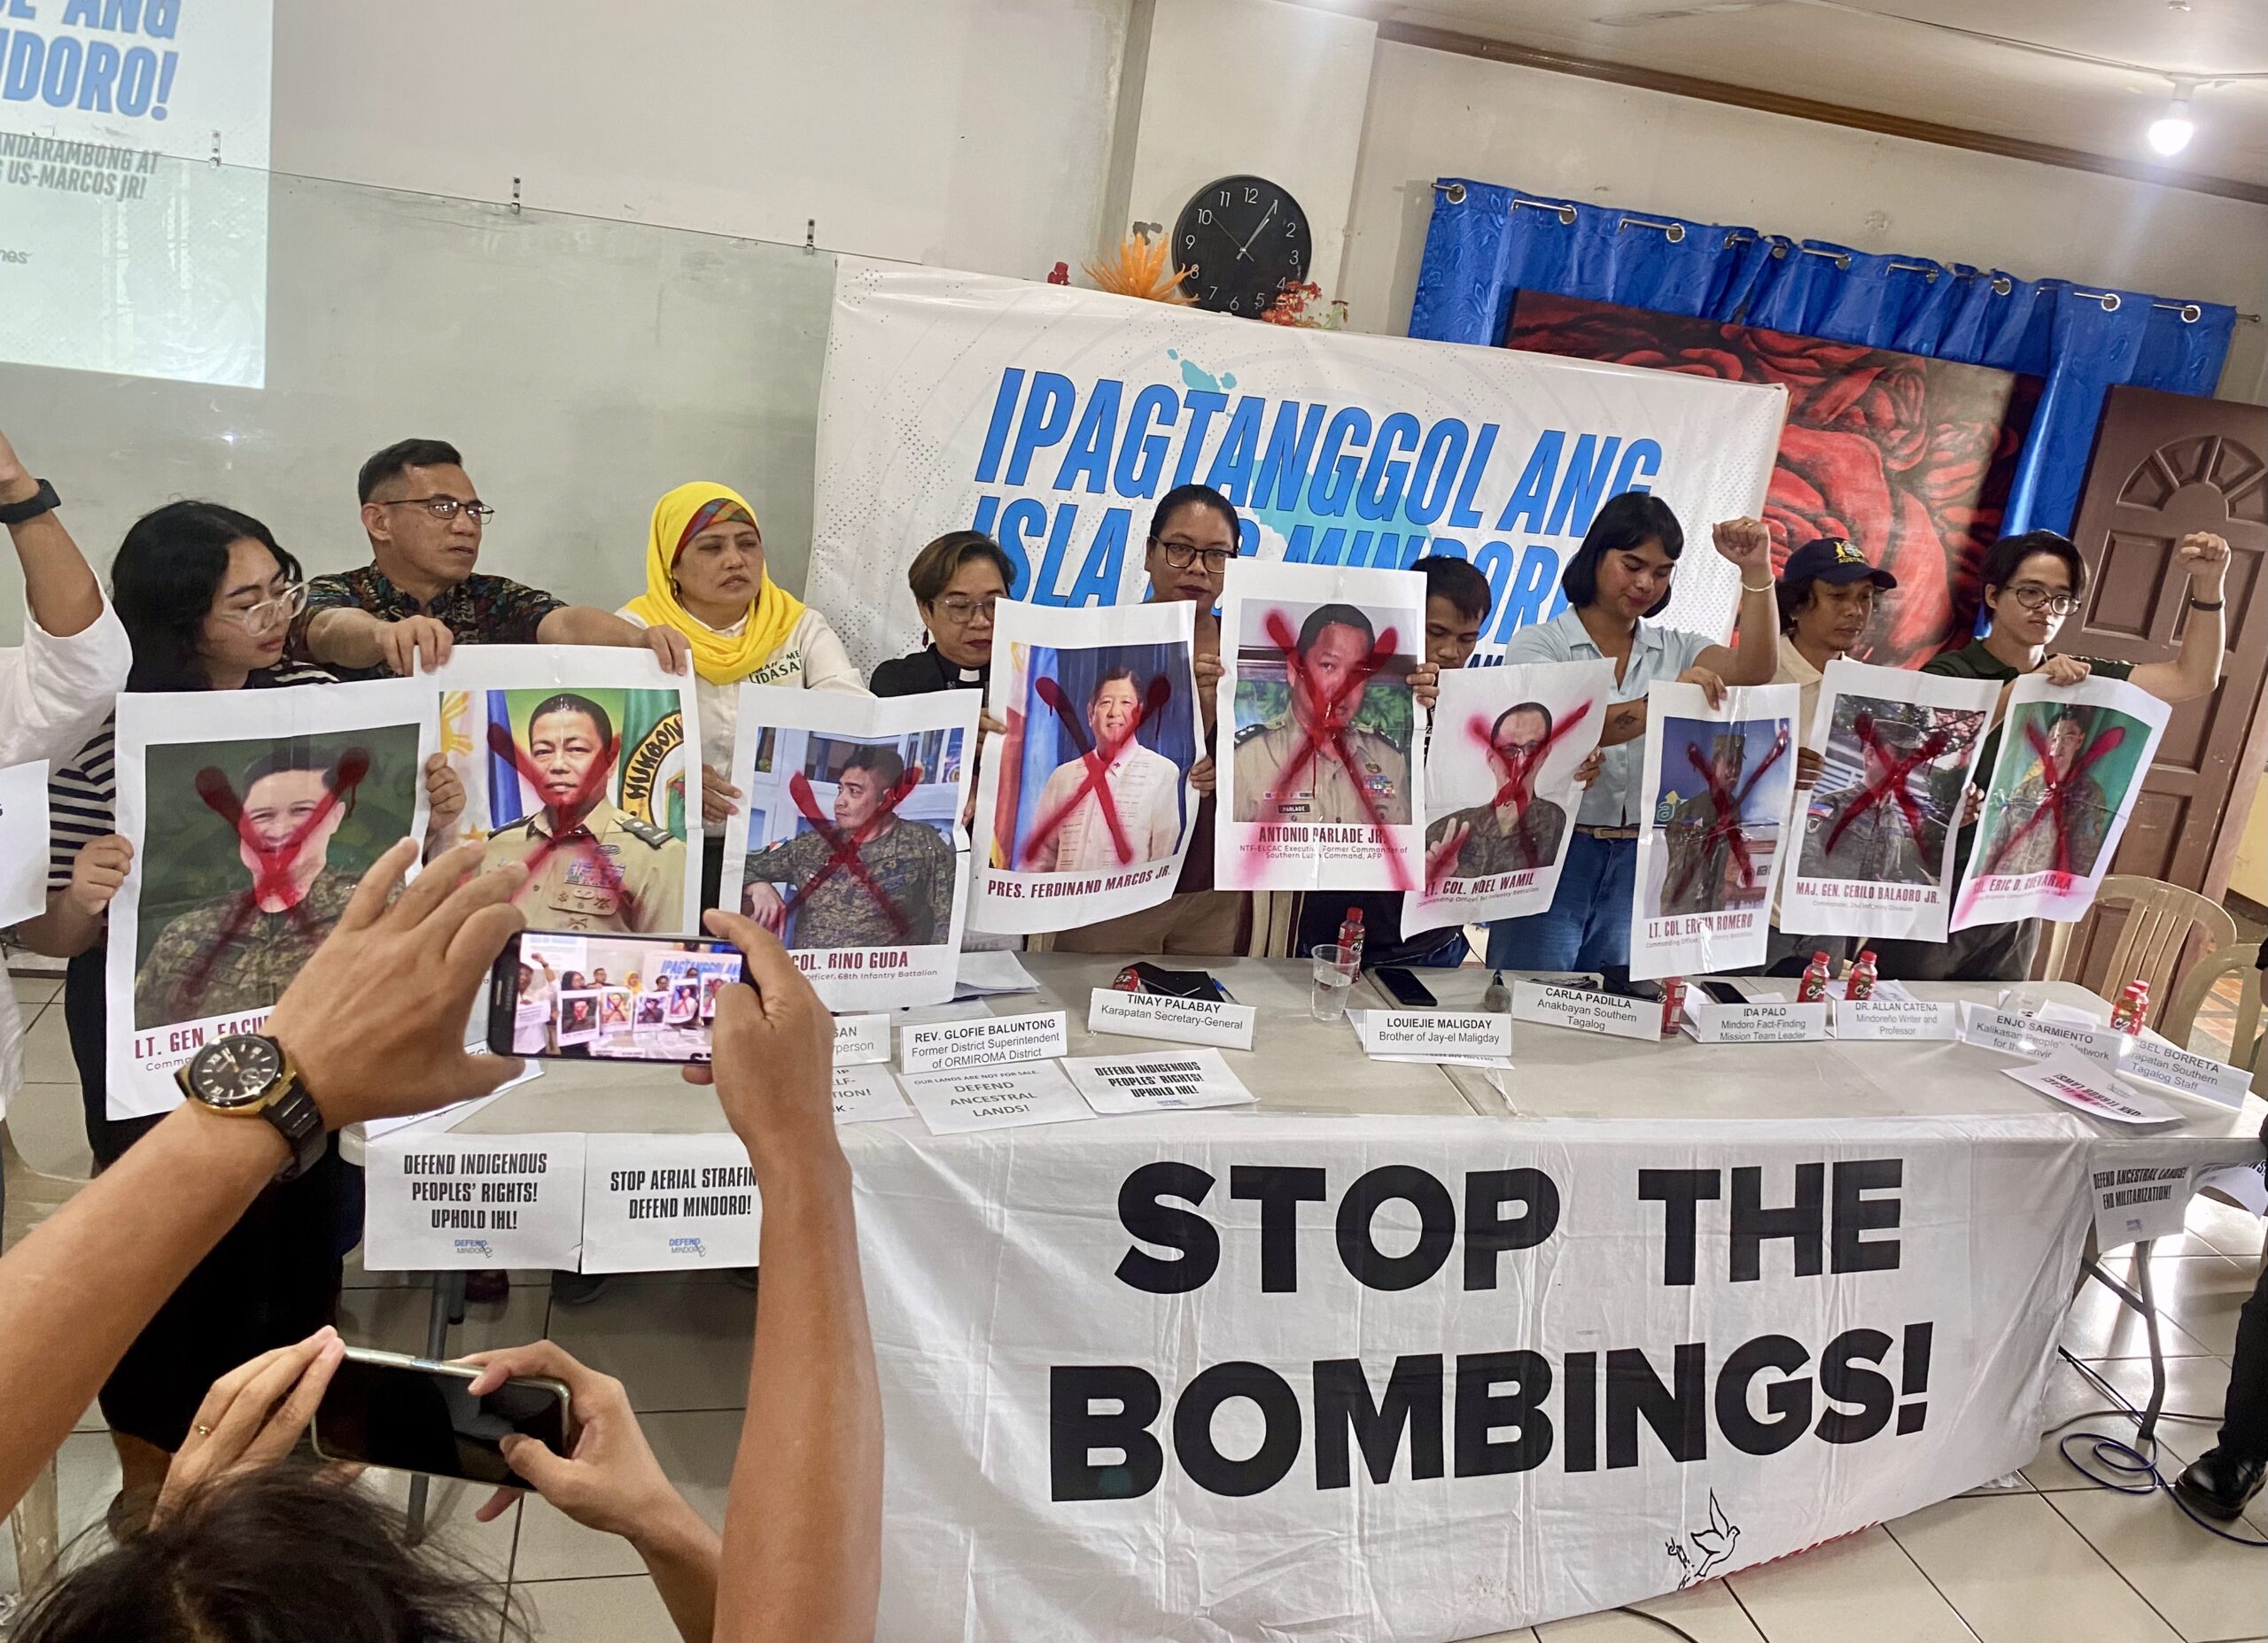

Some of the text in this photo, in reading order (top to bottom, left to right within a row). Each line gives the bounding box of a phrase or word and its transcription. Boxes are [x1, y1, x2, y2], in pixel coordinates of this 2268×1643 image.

[0, 28, 179, 121] DORO!
[8, 162, 147, 202] US-MARCOS JR!
[1220, 191, 1231, 207] 11
[1245, 187, 1259, 204] 12
[1198, 208, 1212, 225] 10
[1285, 222, 1296, 237] 2
[1185, 235, 1196, 250] 9
[1289, 250, 1299, 265] 3
[1276, 276, 1286, 291] 4
[1208, 286, 1218, 300] 7
[1255, 292, 1265, 307] 5
[1229, 296, 1239, 310] 6
[975, 367, 1500, 529] IPAGTANGGOL
[1259, 826, 1309, 842] ANTONIO
[1313, 827, 1363, 843] PARLADE
[1239, 844, 1282, 853] NTF-ELCAC
[1400, 845, 1409, 854] of
[1266, 851, 1304, 860] Southern
[988, 864, 1170, 899] PRES. FERDINAND MARCOS JR.
[1442, 880, 1466, 895] COL.
[1471, 878, 1496, 895] NOEL
[1500, 872, 1534, 890] WAMIL
[1989, 879, 2010, 892] ERIC
[2012, 879, 2021, 891] D.
[1796, 882, 1818, 895] MAJ.
[1821, 884, 1840, 897] GEN.
[1877, 887, 1922, 903] BALAORO
[1924, 891, 1940, 903] JR.
[1649, 922, 1662, 939] LT.
[1665, 919, 1683, 937] COL.
[1717, 913, 1753, 931] ROMERO
[828, 952, 864, 969] RINO
[869, 950, 909, 969] GUDA
[860, 971, 896, 980] Infantry
[898, 968, 938, 979] Battalion
[1127, 994, 1221, 1014] TINAY PALABAY
[1545, 988, 1632, 1009] CARLA PADILLA
[1872, 1003, 1901, 1011] ALLAN
[1903, 1003, 1938, 1011] CATENA
[1101, 1004, 1243, 1029] Karapatan Secretary-General
[1537, 998, 1637, 1023] Anakbayan Southern
[1744, 1007, 1787, 1017] IDA PALO
[1386, 1018, 1492, 1029] LOUIEJIE MALIGDAY
[1567, 1015, 1605, 1031] Tagalog
[1721, 1019, 1806, 1031] Mindoro Fact-Finding
[1923, 1015, 1938, 1024] and
[915, 1019, 1055, 1043] REV. GLOFIE BALUNTONG
[1379, 1031, 1499, 1045] Brother of Jay-el Maligday
[1720, 1031, 1806, 1041] Mission Team Leader
[1879, 1026, 1916, 1035] Professor
[1977, 1022, 2023, 1039] Kalikasan
[1997, 1015, 2026, 1028] ENJO
[2028, 1022, 2093, 1044] SARMIENTO
[135, 1027, 205, 1059] LT. GEN
[835, 1042, 874, 1055] person
[912, 1032, 1060, 1057] Former District Superintendent
[1993, 1038, 2006, 1048] for
[932, 1048, 1042, 1069] of ORMIROMA District
[2164, 1049, 2219, 1073] BORRETA
[1094, 1061, 1201, 1077] DEFEND INDIGENOUS
[2130, 1051, 2218, 1085] rapatan Southern
[2132, 1063, 2199, 1090] Tagalog Staff
[954, 1081, 1014, 1093] DEFEND
[1107, 1073, 1205, 1088] PEOPLES' RIGHTS!
[950, 1091, 1037, 1106] ANCESTRAL
[1130, 1084, 1200, 1098] UPHOLD IHL!
[973, 1104, 1030, 1118] LANDS!
[404, 1153, 548, 1175] DEFEND INDIGENOUS
[610, 1166, 757, 1191] STOP AERIAL STRAFIN
[2093, 1171, 2115, 1190] DEFEND
[2117, 1168, 2157, 1185] ANCESTRAL
[481, 1182, 538, 1203] RIGHTS!
[2102, 1185, 2172, 1210] END MILITARIZATION!
[629, 1195, 751, 1219] DEFEND MINDORO!
[431, 1209, 517, 1229] UPHOLD IHL!
[1114, 1158, 1904, 1294] STOP THE
[669, 1237, 701, 1246] DEFEND
[1049, 1321, 1934, 1503] BOMBINGS!
